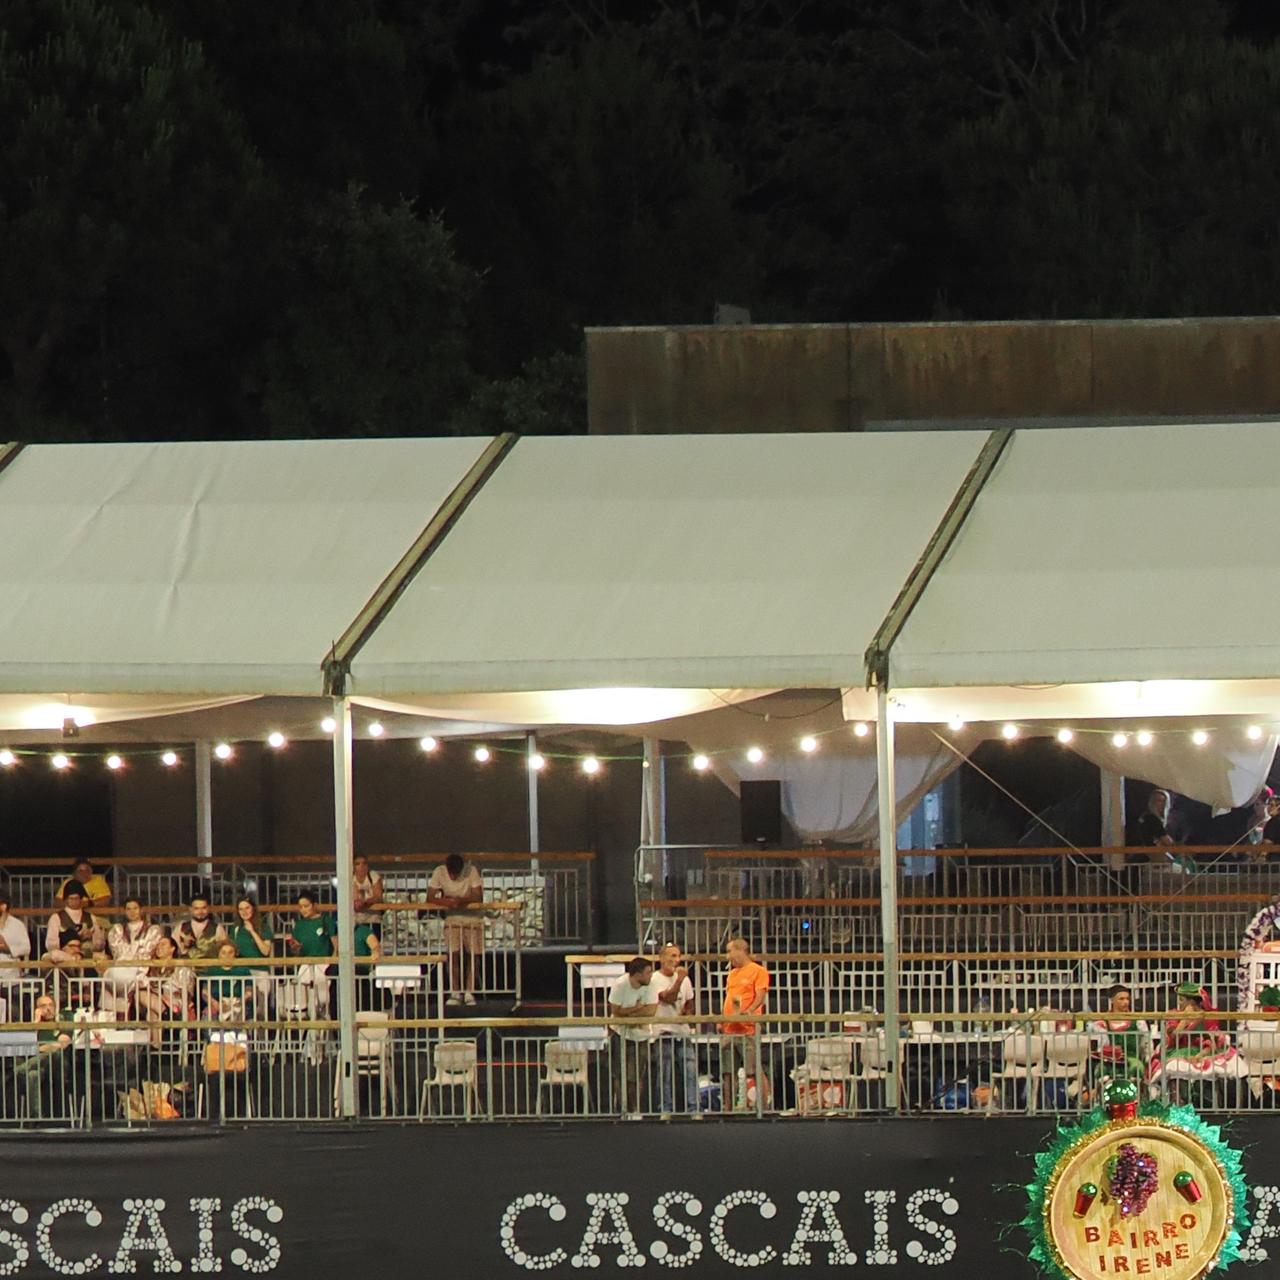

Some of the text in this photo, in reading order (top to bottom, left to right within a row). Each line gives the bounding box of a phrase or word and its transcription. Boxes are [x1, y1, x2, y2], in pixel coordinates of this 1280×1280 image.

[500, 1188, 959, 1270] CASCAIS
[1084, 1213, 1197, 1250] BAIRRO
[1098, 1243, 1190, 1275] IRENE
